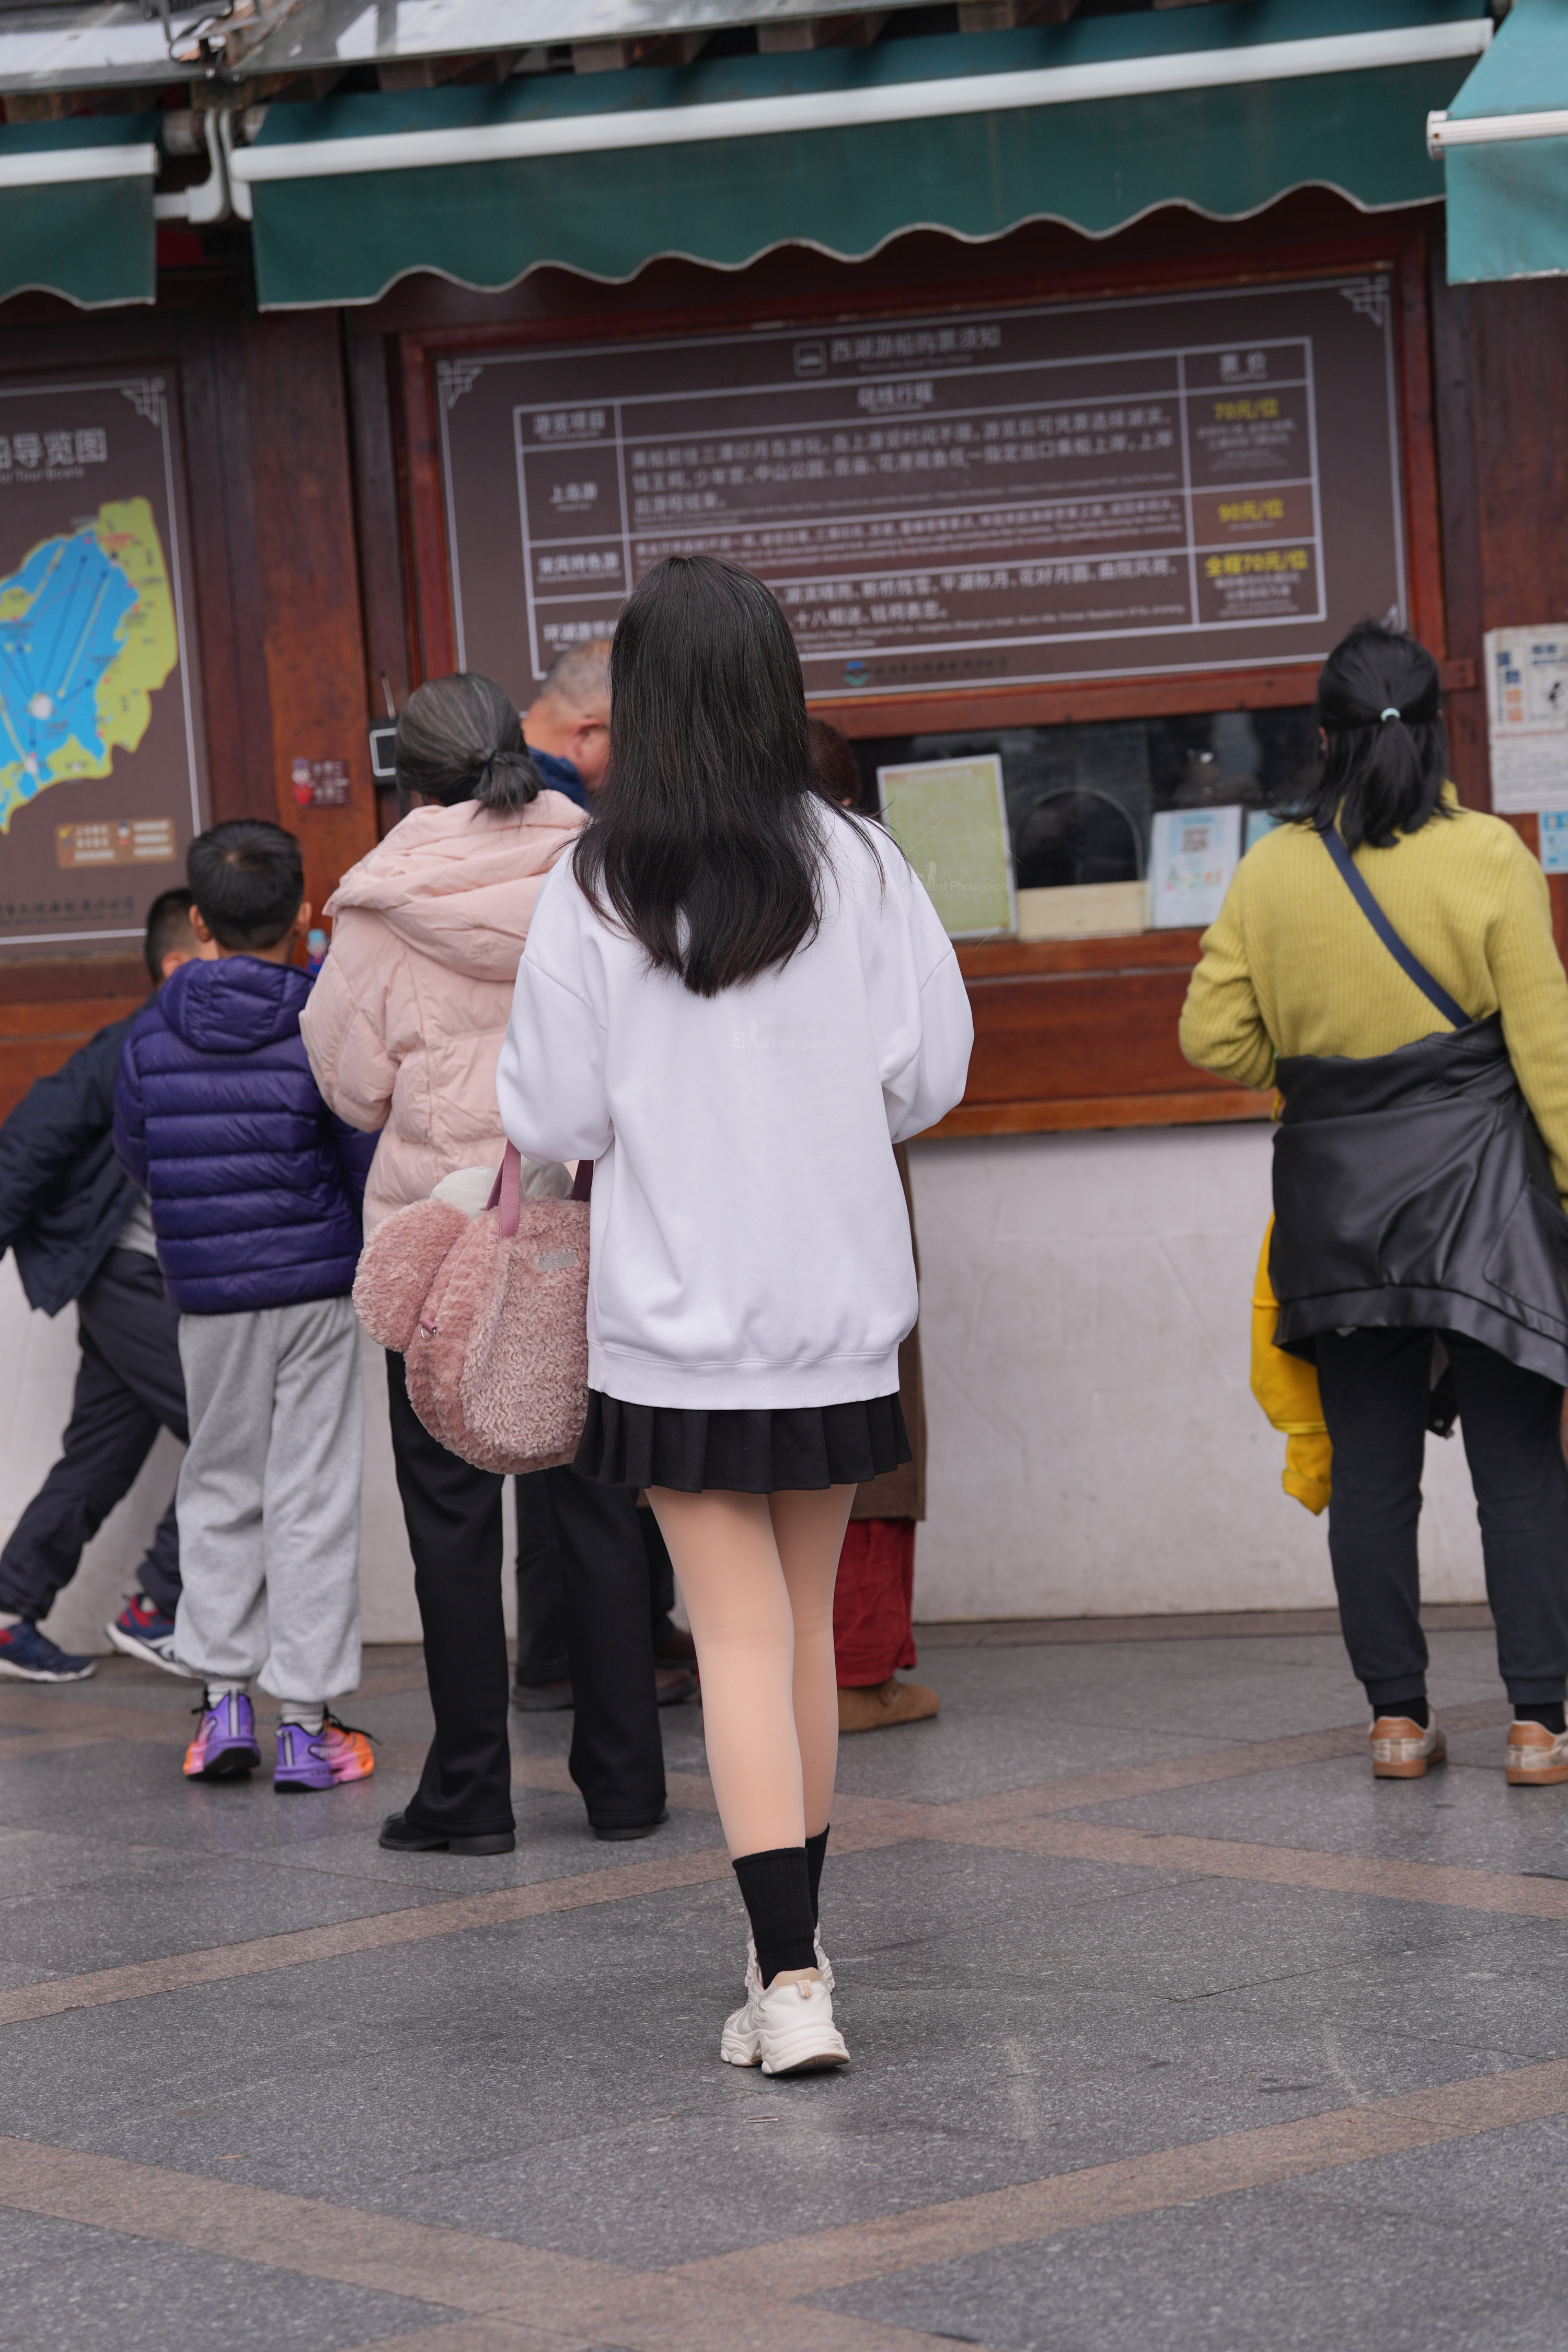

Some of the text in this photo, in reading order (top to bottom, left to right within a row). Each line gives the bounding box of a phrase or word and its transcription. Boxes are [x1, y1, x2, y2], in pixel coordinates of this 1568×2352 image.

[831, 325, 1001, 363] 西湖游船购票须知
[858, 381, 933, 408] 航线行程
[534, 409, 605, 434] 游览项目
[1214, 397, 1279, 421] 70元/位
[549, 481, 598, 504] 上岛游
[1218, 498, 1284, 523] 90元/位
[1205, 548, 1309, 577] 全程70元/位
